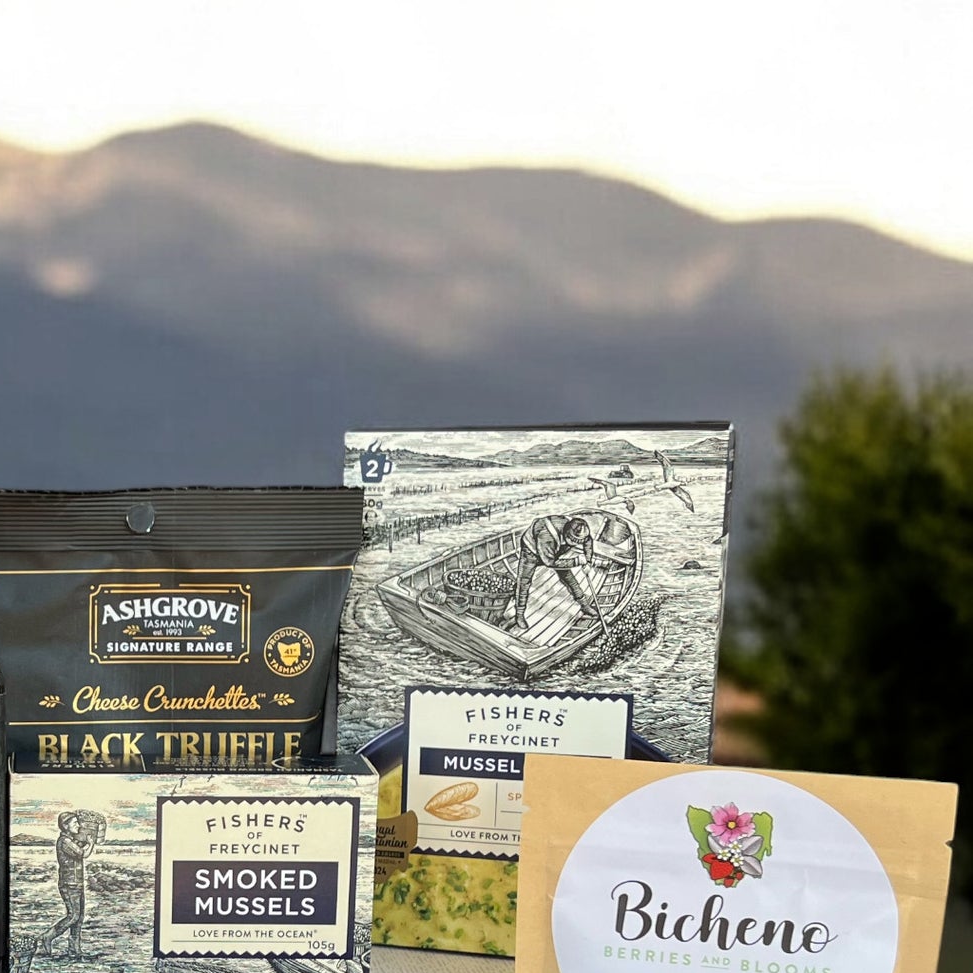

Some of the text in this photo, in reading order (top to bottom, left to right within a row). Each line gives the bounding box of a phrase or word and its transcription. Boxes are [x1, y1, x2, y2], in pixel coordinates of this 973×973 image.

[365, 460, 379, 478] 2
[101, 596, 239, 626] ASHGROVE
[143, 618, 195, 628] TASMANIA
[165, 628, 183, 636] 1993
[107, 641, 233, 652] SIGNATURE RANGE
[267, 630, 311, 650] PRODUCT OF
[270, 658, 309, 674] TASMANIA
[73, 685, 141, 714] Cheese
[507, 724, 522, 732] OF
[469, 734, 560, 748] FREYCINET
[443, 756, 521, 774] MUSSEL
[247, 832, 263, 840] OF
[451, 830, 509, 841] LOVE FROM
[209, 844, 300, 854] FREYCINET
[195, 868, 317, 890] SMOKED
[195, 896, 315, 916] MUSSELS
[611, 880, 839, 954] Bicheno
[193, 930, 219, 938] LOVE
[223, 930, 251, 938] FROM
[255, 930, 273, 938] THE
[309, 940, 335, 950] 105g
[603, 946, 691, 966] BERRIES
[701, 954, 731, 966] AND
